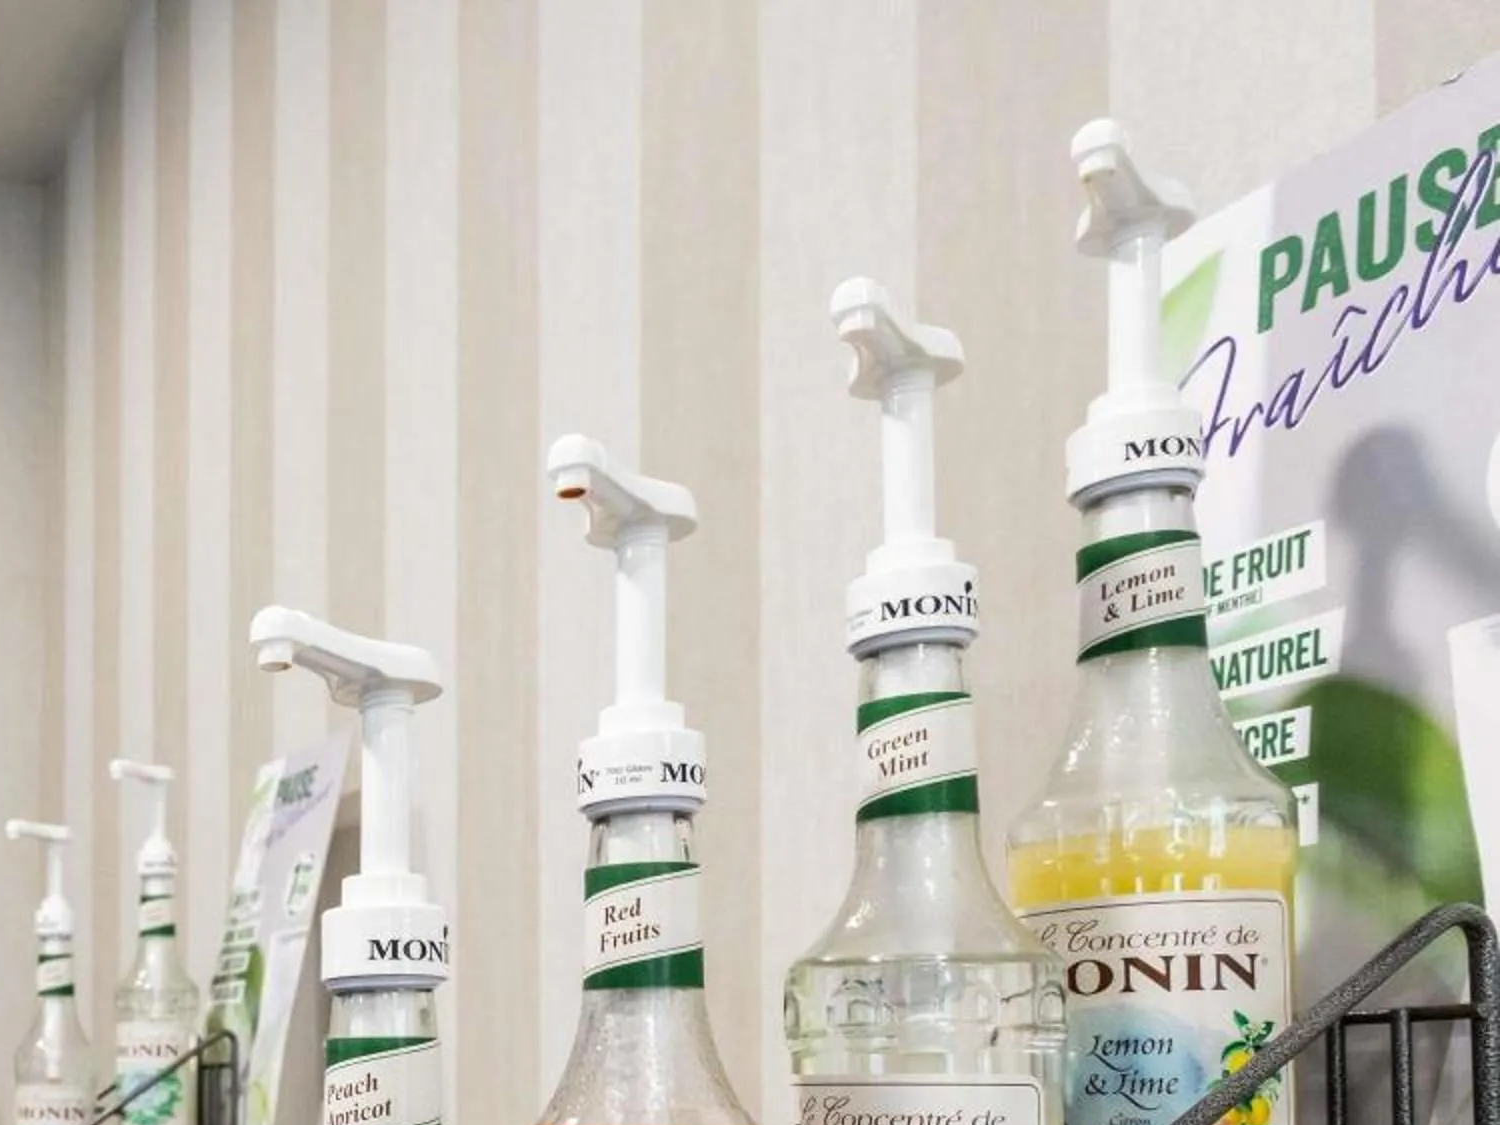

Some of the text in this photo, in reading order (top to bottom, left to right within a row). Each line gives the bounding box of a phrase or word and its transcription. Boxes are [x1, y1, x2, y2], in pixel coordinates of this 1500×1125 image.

[1178, 150, 1500, 459] Fraîch
[1124, 436, 1200, 461] MON
[1232, 529, 1311, 591] FRUIT
[1100, 563, 1176, 600] Lemon
[881, 593, 979, 620] MONI
[1103, 601, 1120, 624] &
[1131, 585, 1185, 613] Lime
[1210, 628, 1327, 690] NATUREL
[867, 727, 929, 760] Green
[1240, 717, 1296, 759] CRE
[878, 750, 929, 778] Mint
[604, 897, 641, 926] Red
[601, 923, 660, 952] Fruits
[1066, 919, 1217, 953] Concentré
[1225, 925, 1260, 946] de
[1067, 953, 1261, 996] ONIN
[1085, 1034, 1173, 1072] Lemon
[327, 1073, 379, 1105] Peach
[1085, 1069, 1179, 1110] & Lime
